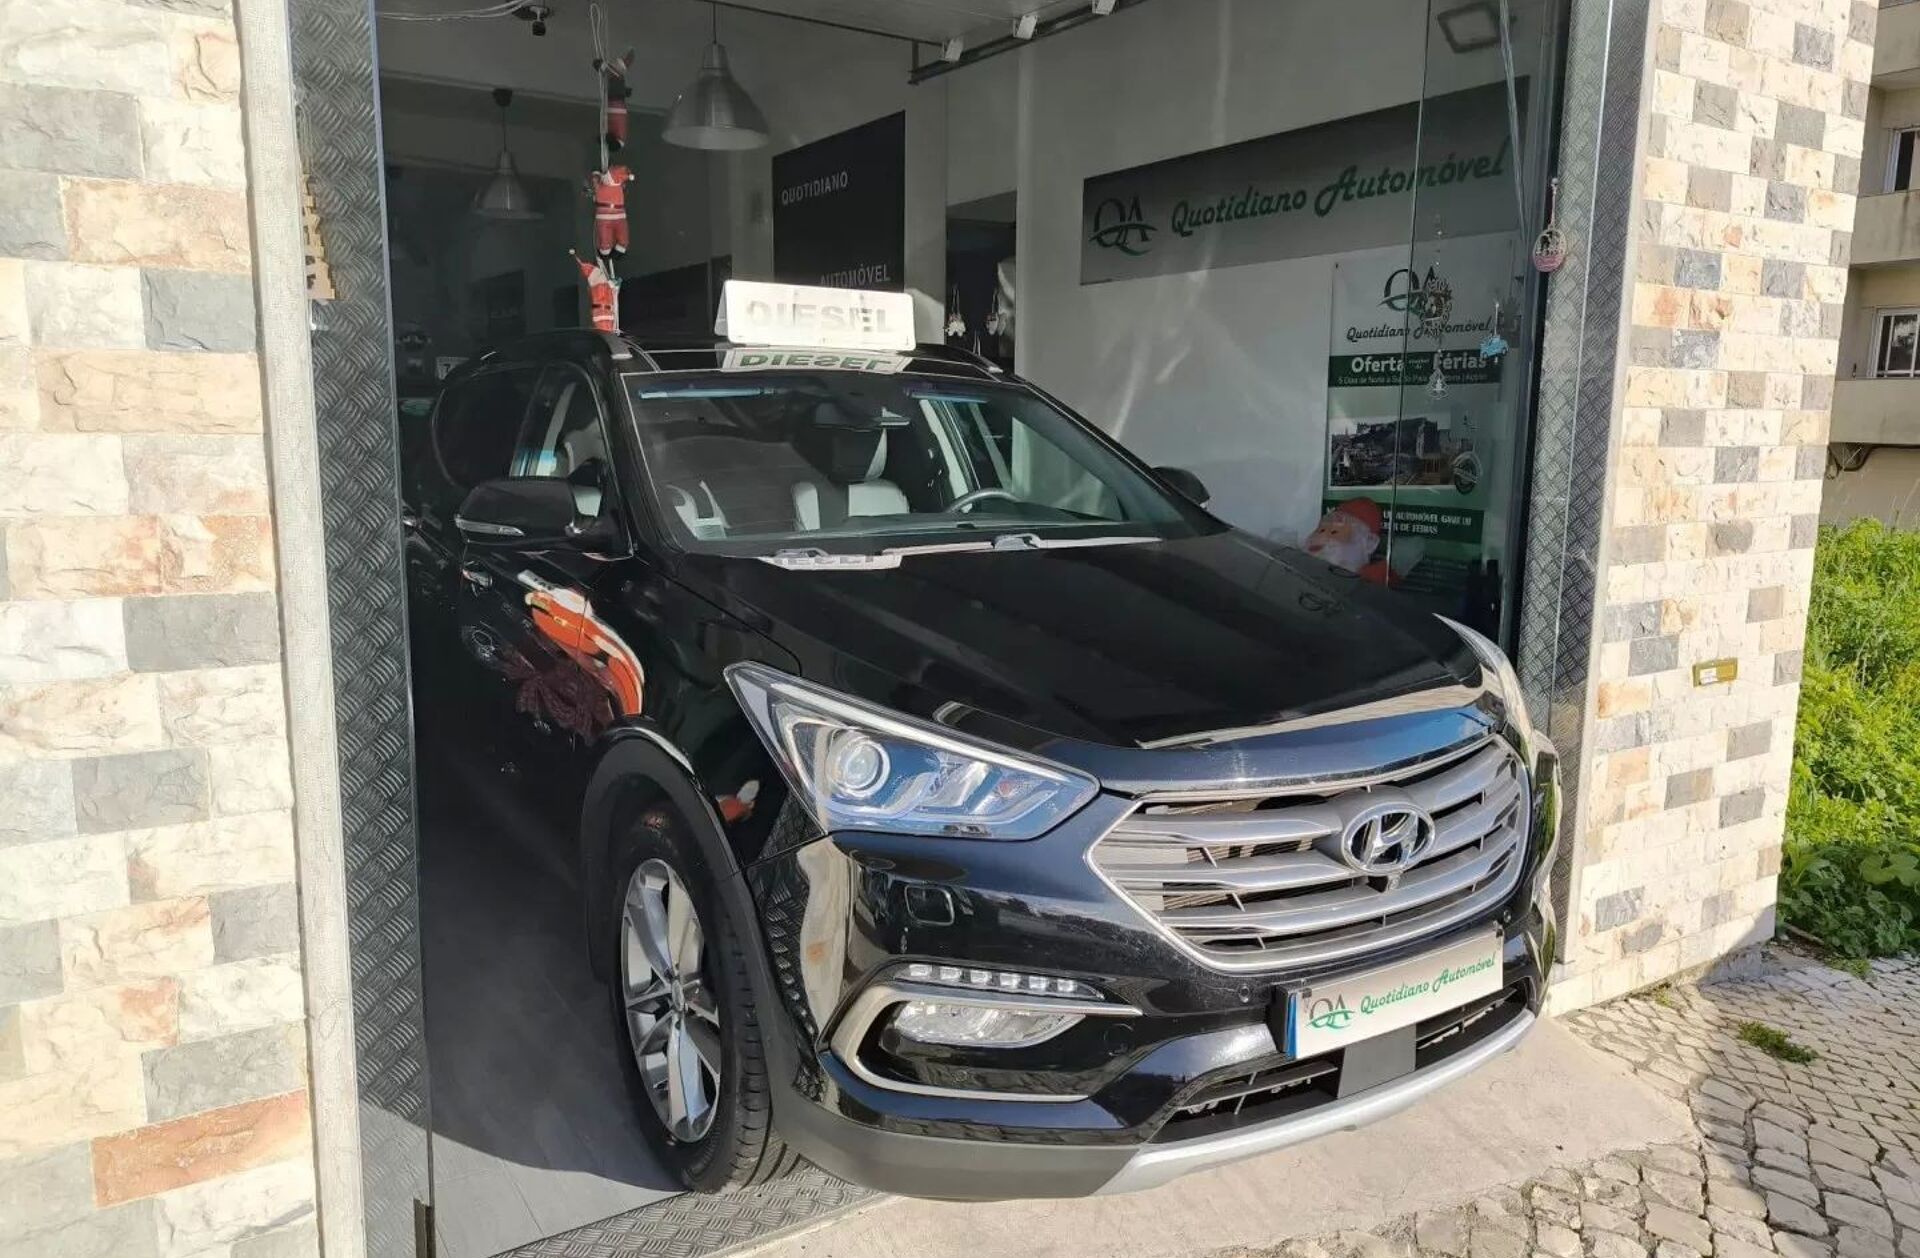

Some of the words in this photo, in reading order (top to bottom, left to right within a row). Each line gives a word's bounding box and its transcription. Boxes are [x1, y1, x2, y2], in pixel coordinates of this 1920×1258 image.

[780, 171, 849, 206] QUOTIDIANO
[1171, 186, 1307, 237] Quotidiano
[1314, 137, 1510, 217] Automóvel
[819, 263, 892, 289] AUTOMÓVEL
[747, 301, 894, 333] DIESEL
[1351, 356, 1404, 373] Oferta
[1360, 982, 1430, 1014] Quotidiano
[1431, 952, 1496, 993] Automóvel
